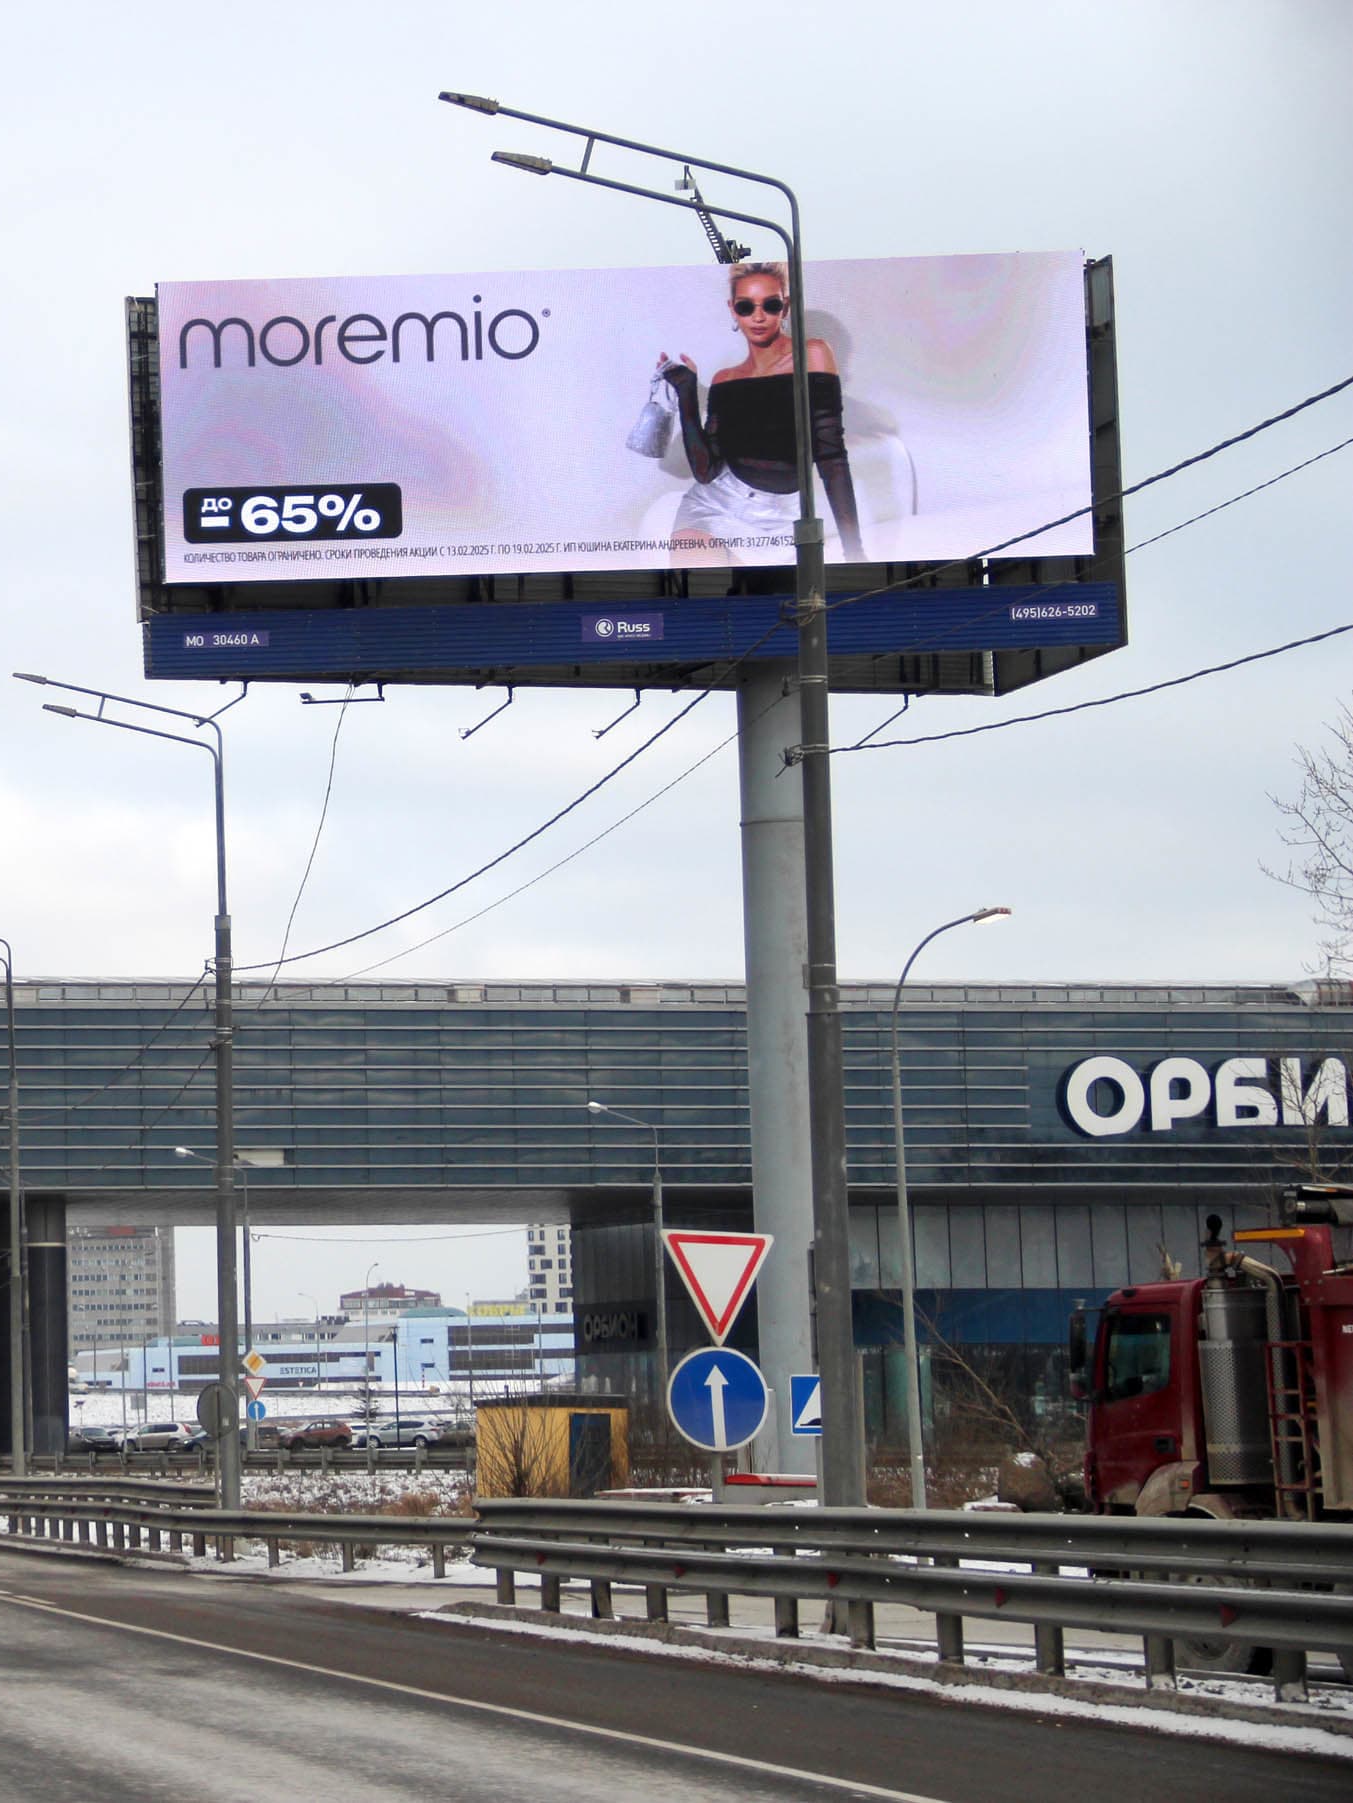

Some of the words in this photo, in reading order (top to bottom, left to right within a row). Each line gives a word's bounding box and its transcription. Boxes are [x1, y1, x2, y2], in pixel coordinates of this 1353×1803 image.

[183, 552, 236, 563] КОЛИЧЕСТВО
[238, 551, 266, 562] ТОВАРА
[325, 548, 352, 560] СРОКИ
[354, 547, 408, 560] ПРОВЕДЕНИЯ
[409, 546, 437, 559] АКЦИИ
[439, 546, 445, 556] С
[448, 545, 489, 556] 13.02.2025
[497, 544, 511, 554] ПО
[512, 543, 554, 554] 19.02.2025
[564, 543, 577, 553] ИП
[578, 540, 612, 552] ЮШИНА
[613, 537, 657, 551] ЕКАТЕРИНА
[746, 535, 795, 548] 3127746152
[1012, 604, 1096, 620] (495)626-5202
[617, 621, 651, 633] Russ
[213, 634, 248, 646] 30460
[279, 1366, 317, 1375] ESTETICA
